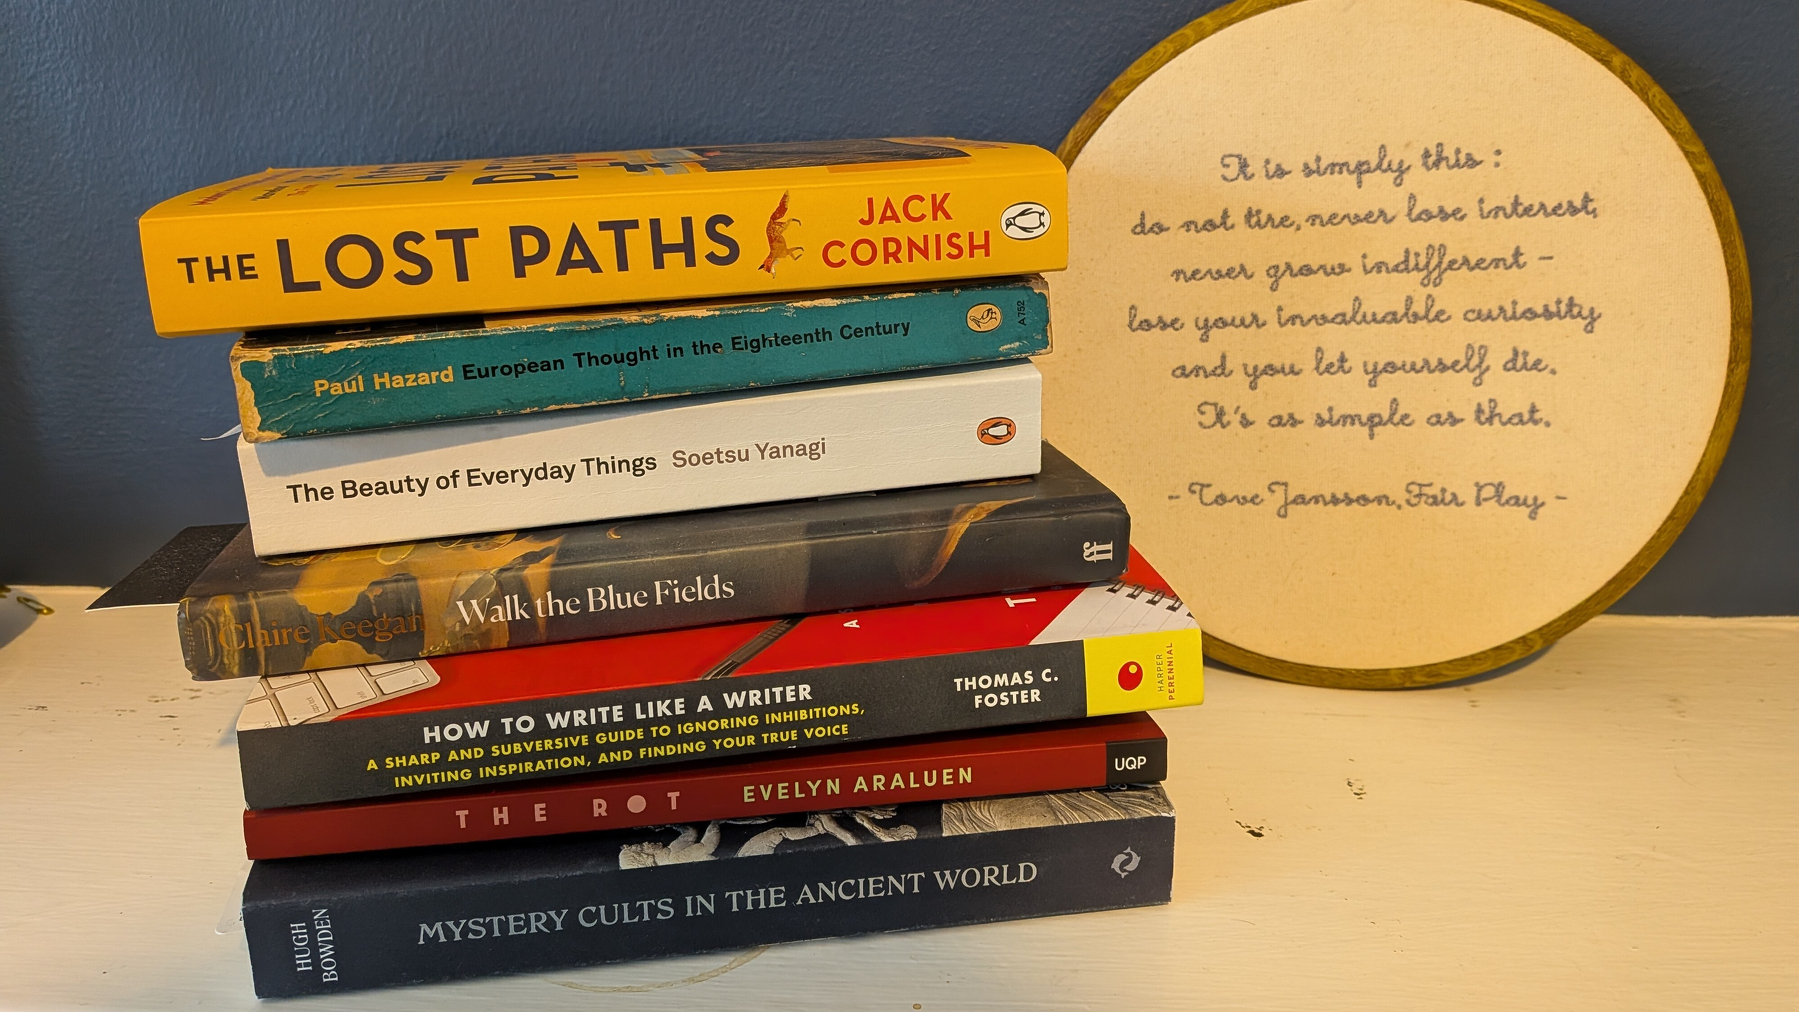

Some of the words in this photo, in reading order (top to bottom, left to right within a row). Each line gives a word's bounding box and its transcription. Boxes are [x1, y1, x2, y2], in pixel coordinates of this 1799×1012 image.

[1220, 154, 1255, 183] It
[1264, 154, 1292, 180] is
[1301, 144, 1410, 188] simply
[1421, 142, 1484, 171] this
[859, 192, 953, 226] JACK
[1131, 211, 1170, 236] do
[1178, 208, 1235, 234] not
[1305, 206, 1395, 229] never
[1404, 192, 1466, 224] lose
[1477, 192, 1599, 221] interest,
[178, 254, 259, 284] THE
[276, 228, 479, 293] LOST
[509, 214, 740, 278] PATHS
[822, 230, 991, 269] CORNISH
[1171, 262, 1254, 284] never
[1266, 261, 1351, 292] grow
[1360, 244, 1527, 288] indifferent
[1127, 305, 1185, 333] lose
[1194, 312, 1268, 343] your
[1276, 296, 1452, 328] invaluable
[1462, 298, 1602, 334] curiosity
[314, 376, 364, 397] Paul
[374, 366, 454, 391] Hazard
[462, 357, 565, 381] European
[573, 344, 659, 370] Thought
[666, 343, 684, 359] in
[692, 340, 723, 356] the
[731, 327, 833, 354] Eighteenth
[840, 320, 911, 342] Century
[1171, 352, 1234, 380] and
[1243, 362, 1301, 391] you
[1313, 346, 1353, 377] let
[1361, 344, 1489, 388] yourself
[1502, 346, 1558, 376] die.
[1197, 402, 1255, 430] It's
[1266, 413, 1303, 429] as
[1313, 397, 1415, 440] simple
[1425, 410, 1465, 427] as
[1473, 397, 1552, 429] that.
[286, 483, 334, 504] The
[341, 475, 429, 499] Beauty
[436, 470, 460, 490] of
[467, 461, 576, 488] Everyday
[581, 454, 657, 476] Things
[672, 444, 750, 468] Soetsu
[754, 438, 827, 461] Yanagi
[1188, 482, 1264, 509] Tove
[1405, 482, 1466, 510] Fair
[1474, 481, 1546, 520] Play
[218, 622, 310, 651] Claire
[317, 613, 426, 642] Keegan
[456, 595, 529, 625] Walk
[535, 591, 581, 619] the
[587, 585, 648, 613] Blue
[656, 575, 734, 605] Fields
[954, 671, 1033, 692] THOMAS
[1041, 669, 1059, 683] C.
[1156, 653, 1164, 692] HARPER
[1167, 642, 1175, 700] PERENNIAL
[423, 720, 491, 744] HOW
[501, 715, 535, 735] TO
[545, 703, 624, 730] WRITE
[635, 698, 686, 719] LIKE
[697, 695, 714, 711] A
[723, 684, 812, 709] WRITER
[974, 689, 1041, 708] FOSTER
[366, 759, 378, 771] A
[385, 750, 441, 769] SHARP
[448, 747, 485, 762] AND
[491, 734, 589, 757] SUBVERSIVE
[595, 727, 645, 744] GUIDE
[651, 724, 671, 737] TO
[677, 713, 759, 734] IGNORING
[765, 703, 865, 724] INHIBITIONS,
[394, 768, 472, 788] INVITING
[479, 755, 592, 778] INSPIRATION,
[597, 749, 633, 764] AND
[640, 741, 706, 758] FINDING
[713, 733, 757, 748] YOUR
[761, 728, 800, 744] TRUE
[804, 723, 849, 738] VOICE
[1115, 755, 1146, 771] UQP
[455, 803, 546, 828] THE
[743, 779, 841, 803] EVELYN
[853, 767, 973, 793] ARALUEN
[418, 909, 568, 944] MYSTERY
[577, 898, 674, 928] CULTS
[685, 893, 715, 917] IN
[725, 886, 787, 912] THE
[796, 872, 925, 905] ANCIENT
[932, 861, 1038, 889] WORLD
[291, 922, 313, 972] HUGH
[315, 908, 338, 982] BOWDEN
